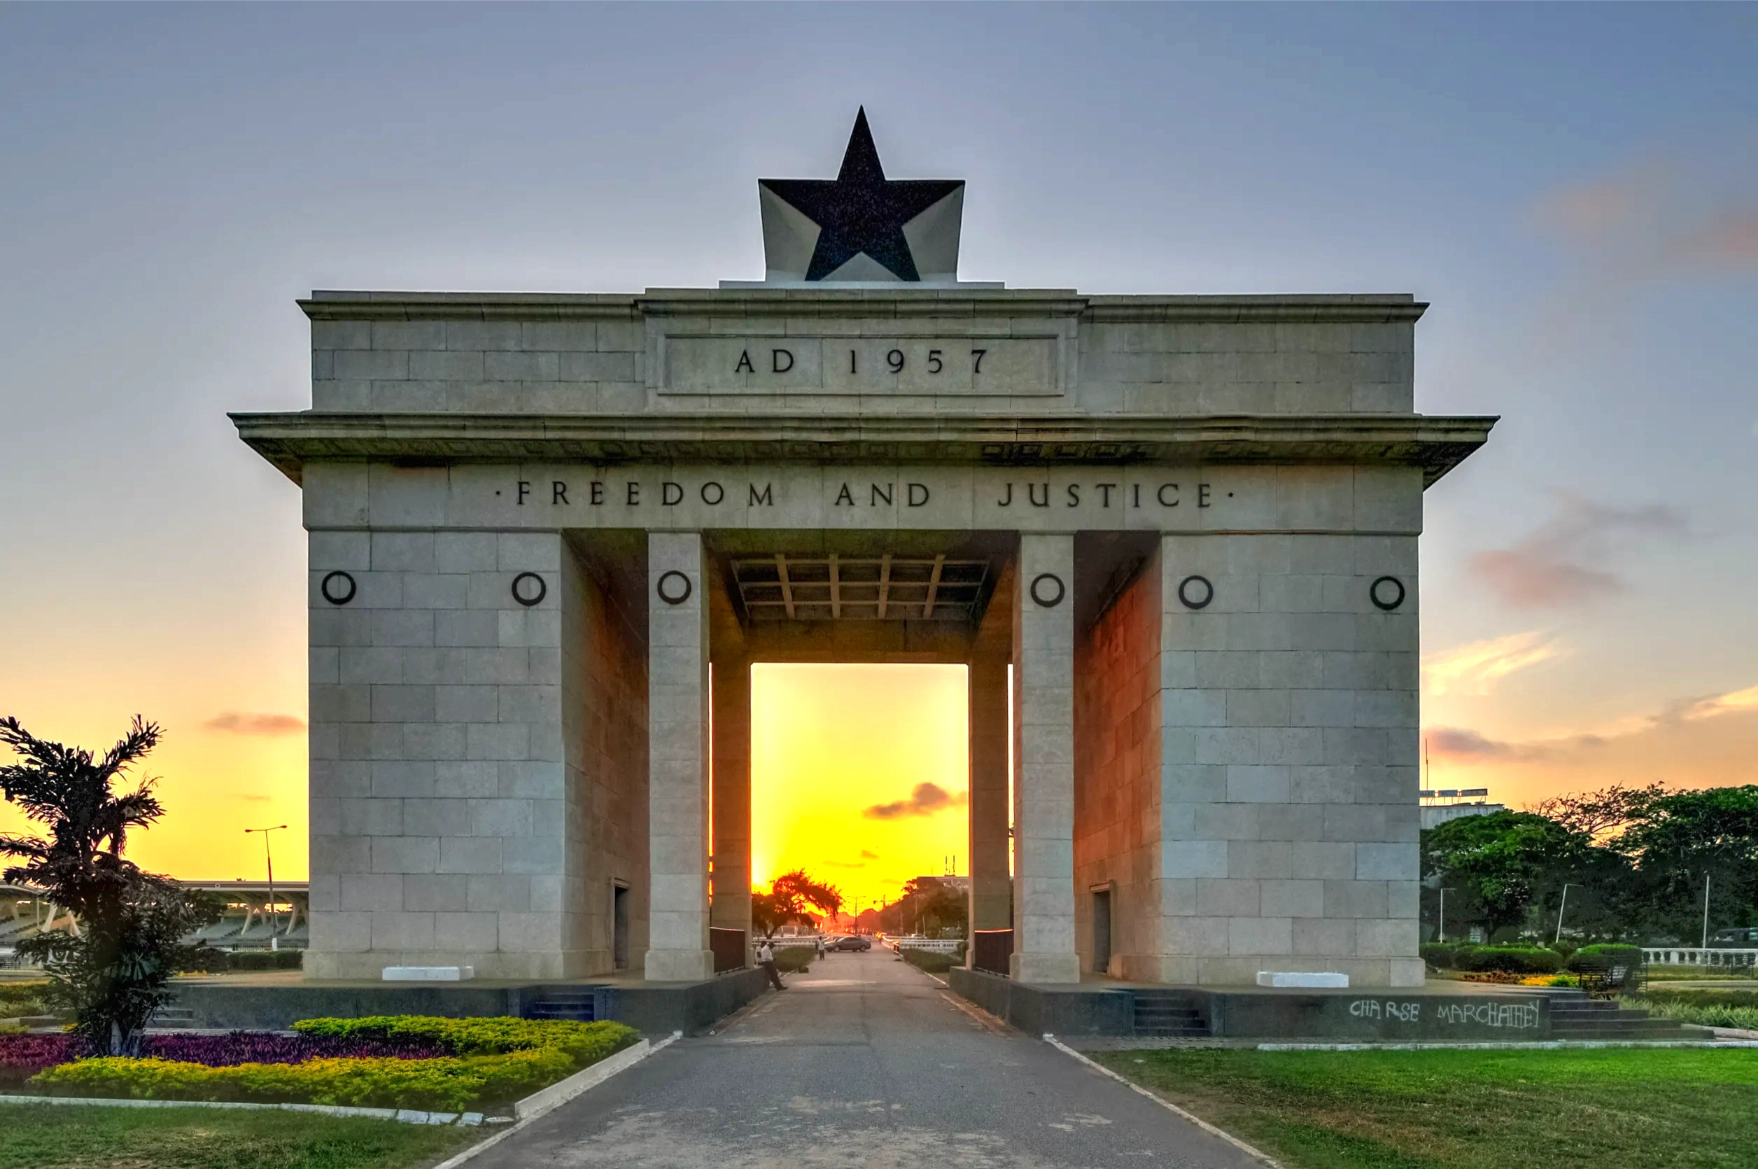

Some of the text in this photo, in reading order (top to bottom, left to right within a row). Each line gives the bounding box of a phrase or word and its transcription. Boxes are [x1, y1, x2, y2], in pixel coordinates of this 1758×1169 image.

[735, 349, 988, 375] AD 1957
[516, 481, 1212, 508] FREEDOM AND JUSTICE
